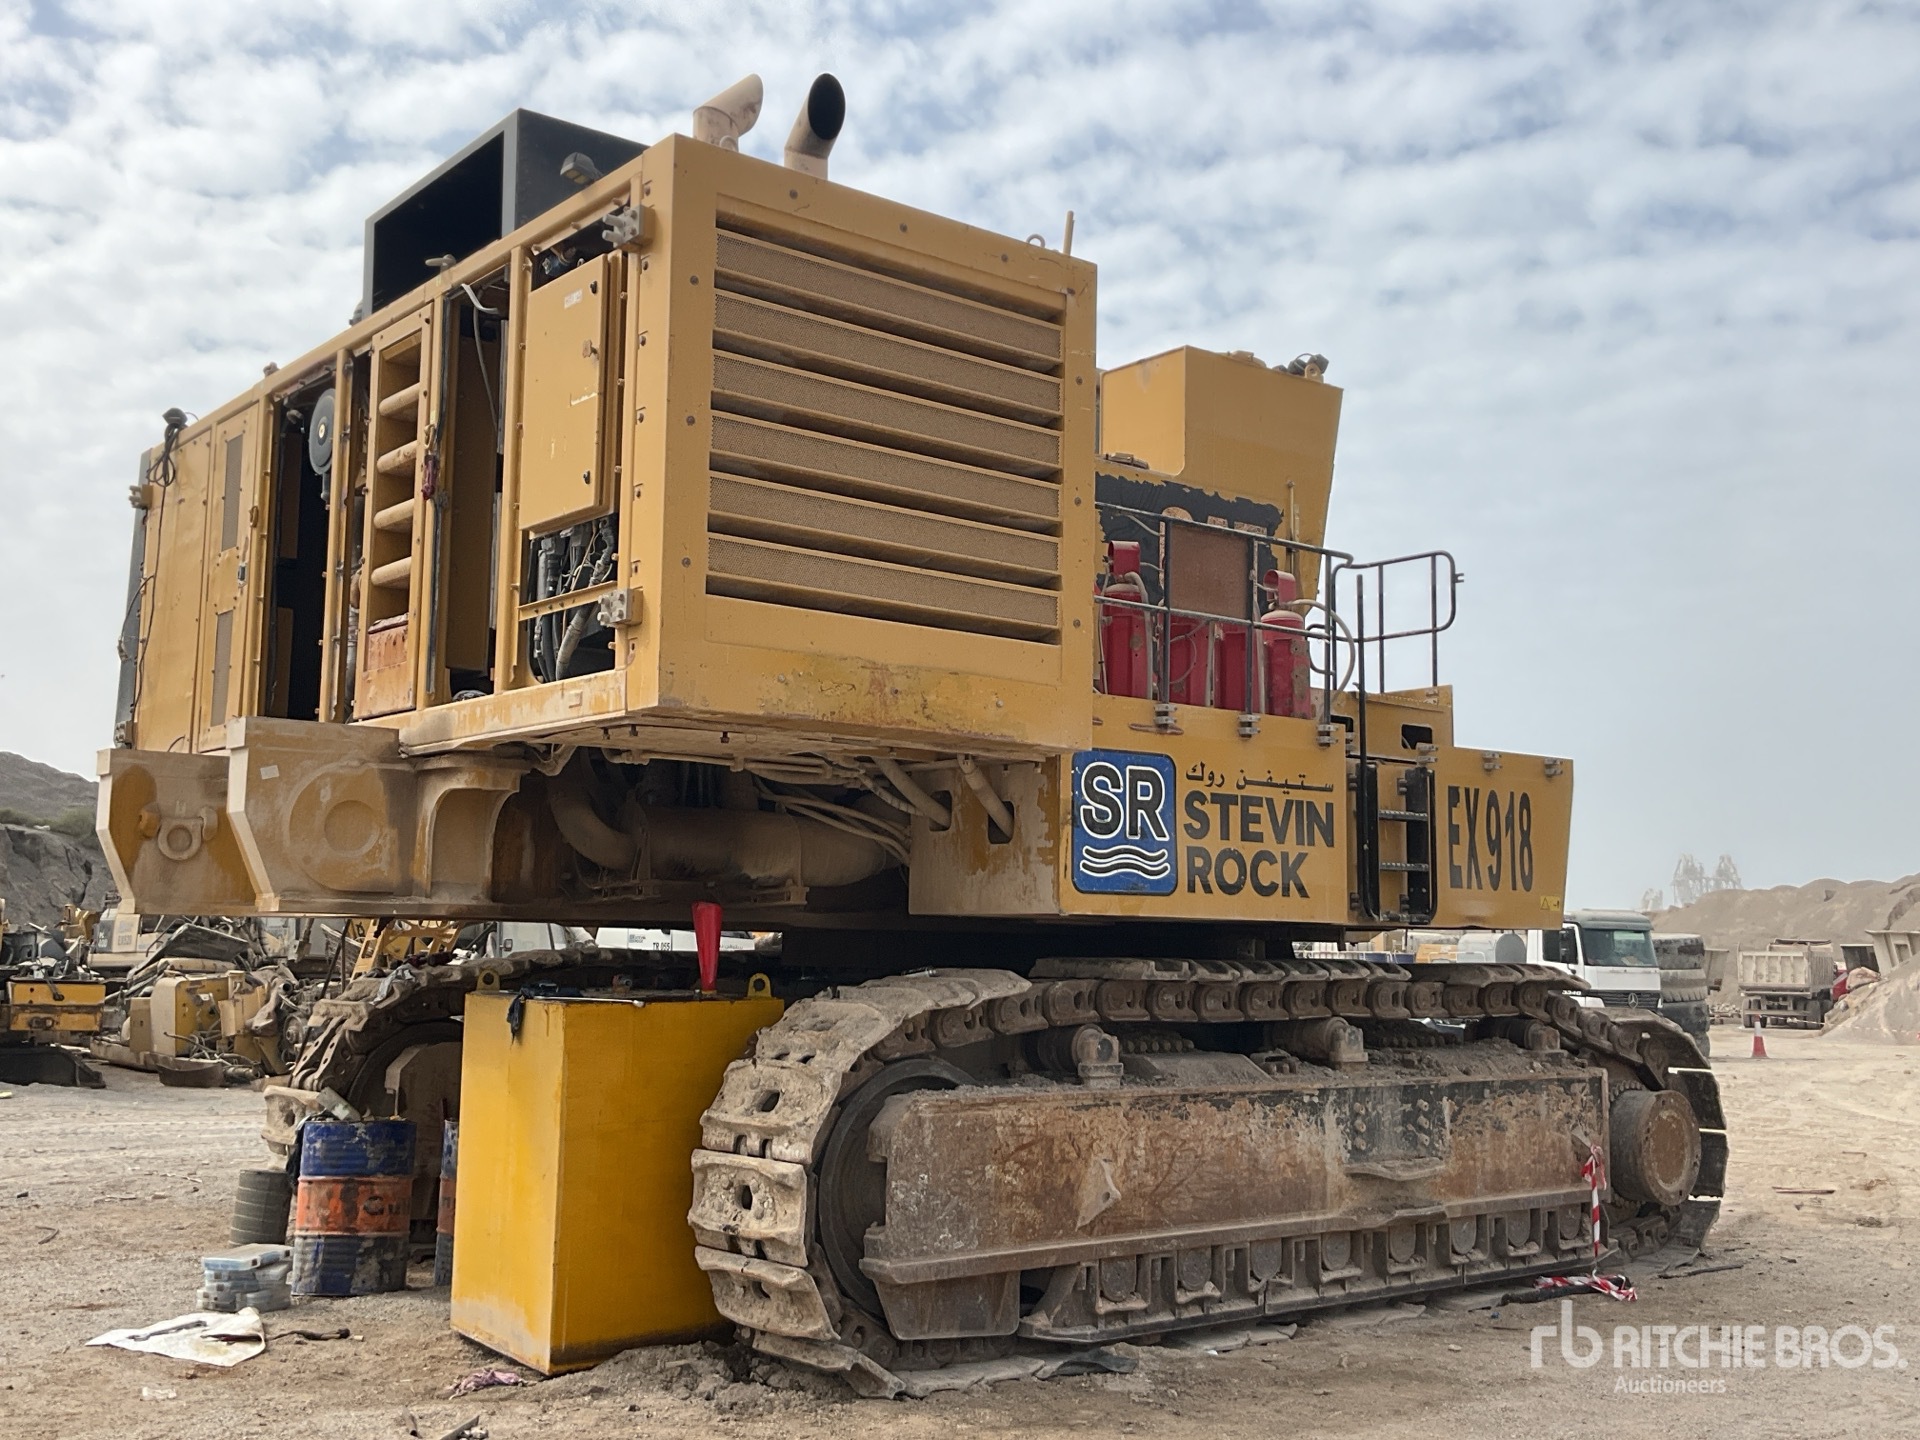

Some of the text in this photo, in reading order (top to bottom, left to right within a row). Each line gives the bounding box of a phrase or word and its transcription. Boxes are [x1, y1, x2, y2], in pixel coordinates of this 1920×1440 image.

[1080, 761, 1170, 841] SR
[1183, 790, 1335, 848] STEVIN
[1186, 845, 1310, 898] ROCK
[1447, 785, 1533, 893] EX918
